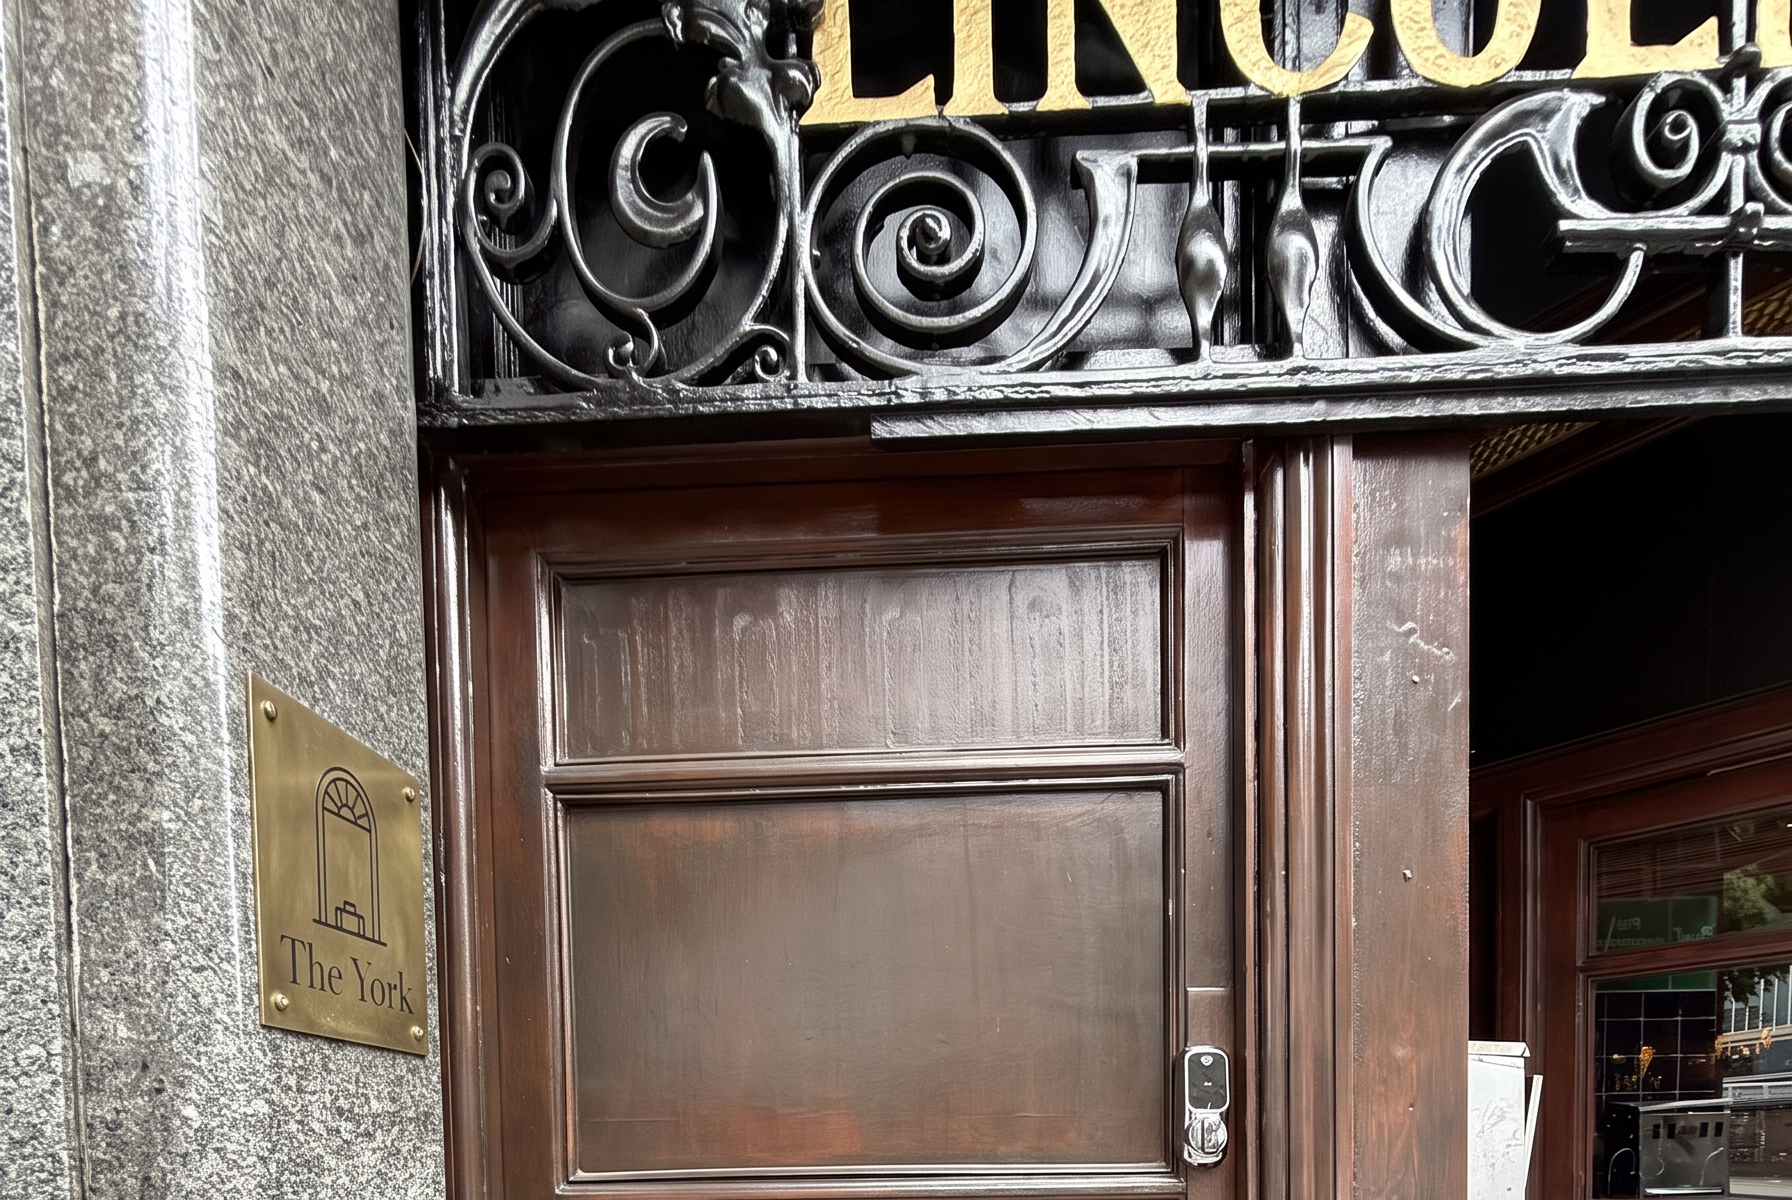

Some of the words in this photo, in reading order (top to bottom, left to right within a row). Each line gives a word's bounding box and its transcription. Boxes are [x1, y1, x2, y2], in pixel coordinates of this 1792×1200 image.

[799, 0, 1792, 125] LINCOL
[280, 934, 343, 996] The
[350, 957, 415, 1014] York
